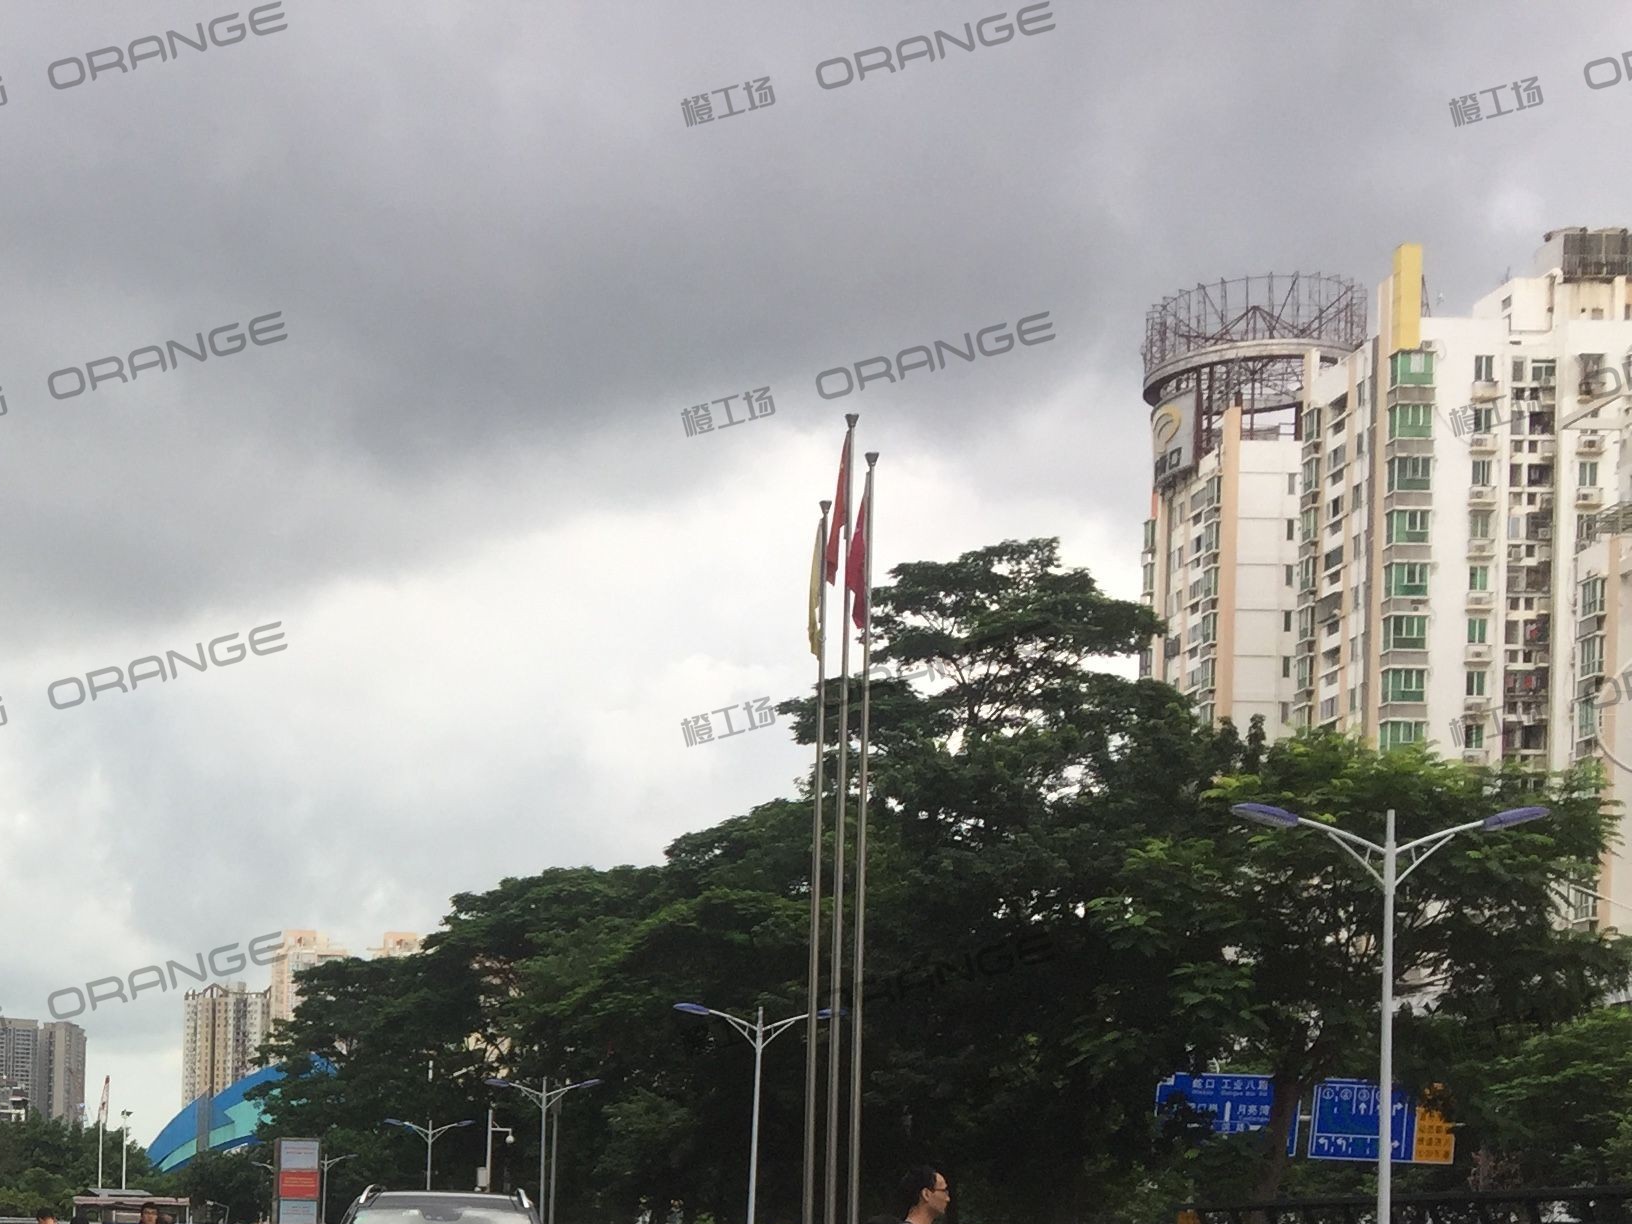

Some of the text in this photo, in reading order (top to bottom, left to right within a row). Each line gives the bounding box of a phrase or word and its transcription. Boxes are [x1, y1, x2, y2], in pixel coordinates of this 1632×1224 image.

[1192, 1078, 1269, 1090] 蛇口 工业八路
[1236, 1104, 1271, 1116] 月亮湾
